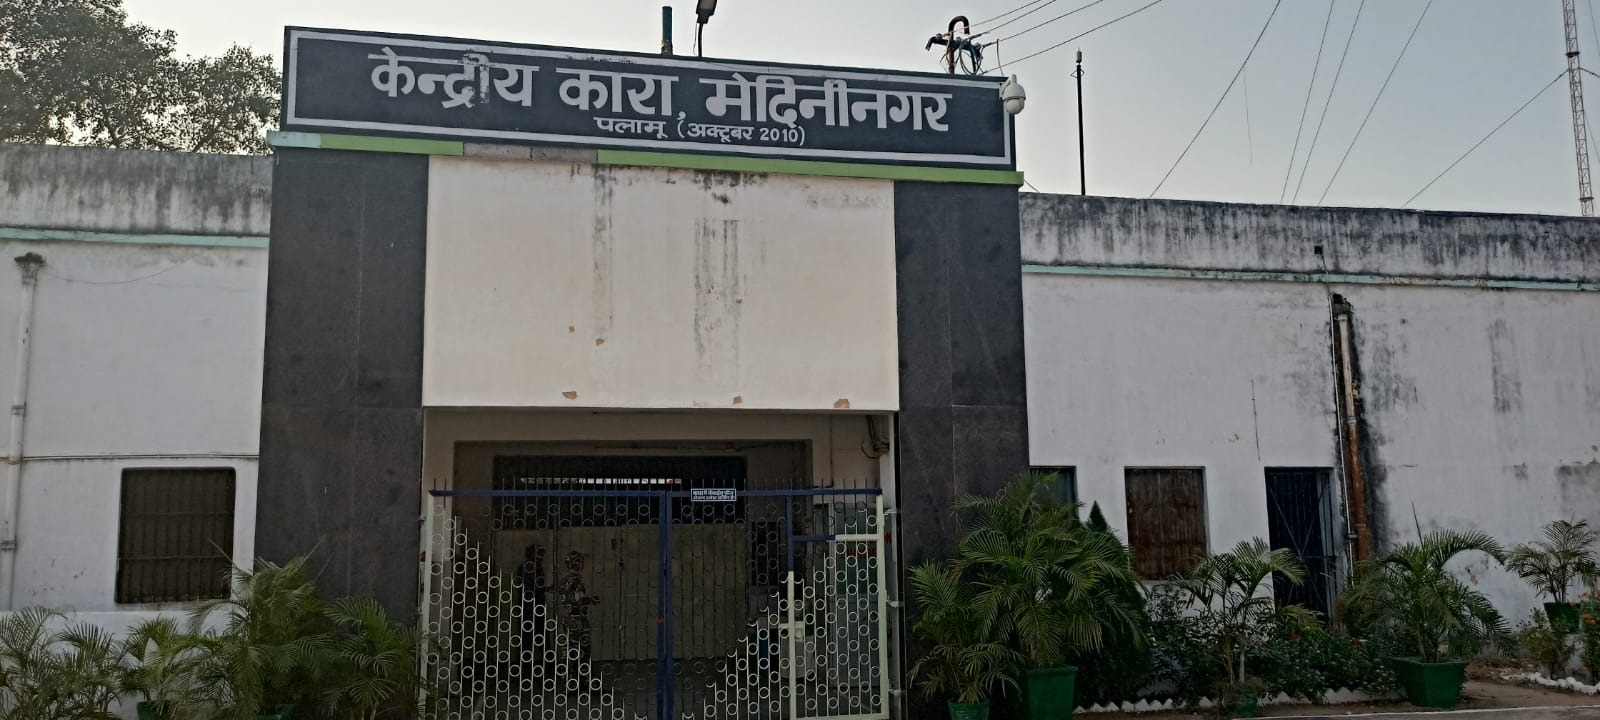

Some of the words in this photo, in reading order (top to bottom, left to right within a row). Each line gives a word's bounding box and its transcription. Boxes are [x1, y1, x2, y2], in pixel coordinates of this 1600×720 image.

[367, 46, 540, 108] केन्द्रीय
[555, 67, 686, 119] कारा,
[699, 72, 953, 131] मेदिनीनगर
[592, 116, 668, 138] पलामू
[676, 120, 755, 143] (अक्टूबर
[758, 126, 806, 146] 2010)
